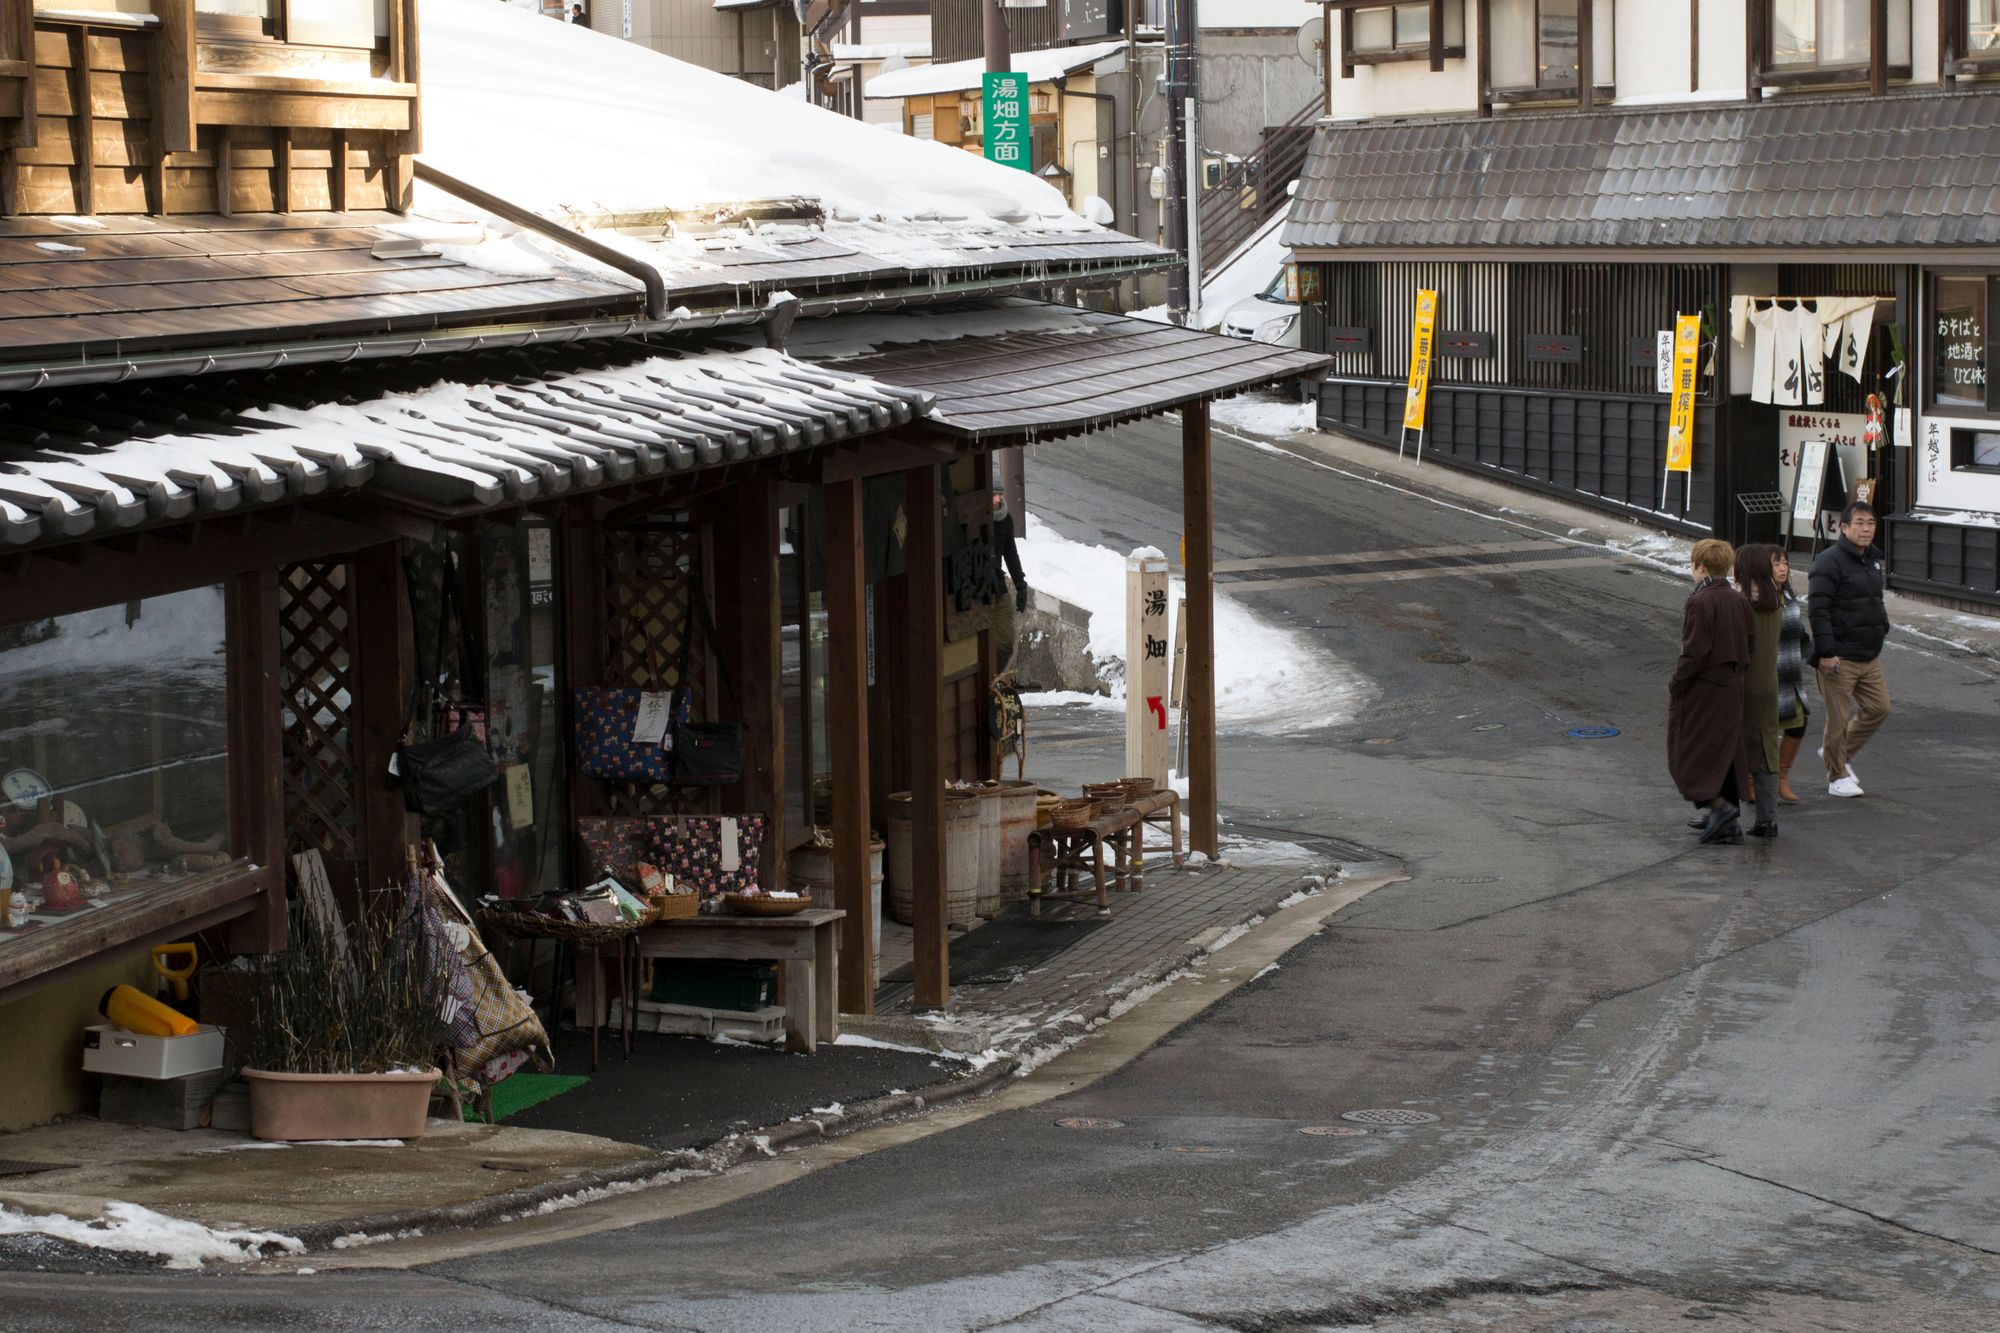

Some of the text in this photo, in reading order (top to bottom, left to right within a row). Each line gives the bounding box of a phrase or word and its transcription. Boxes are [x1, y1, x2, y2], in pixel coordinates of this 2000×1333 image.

[992, 78, 1020, 161] 湯畑方面
[1938, 317, 1980, 337] おそばと
[1948, 342, 1983, 361] 地酒で
[1414, 327, 1431, 397] 一番搾り
[1954, 367, 1986, 385] ひと休
[1677, 357, 1693, 435] 一番搾り
[1927, 422, 1940, 484] 年越そば
[1144, 589, 1167, 661] 湯畑
